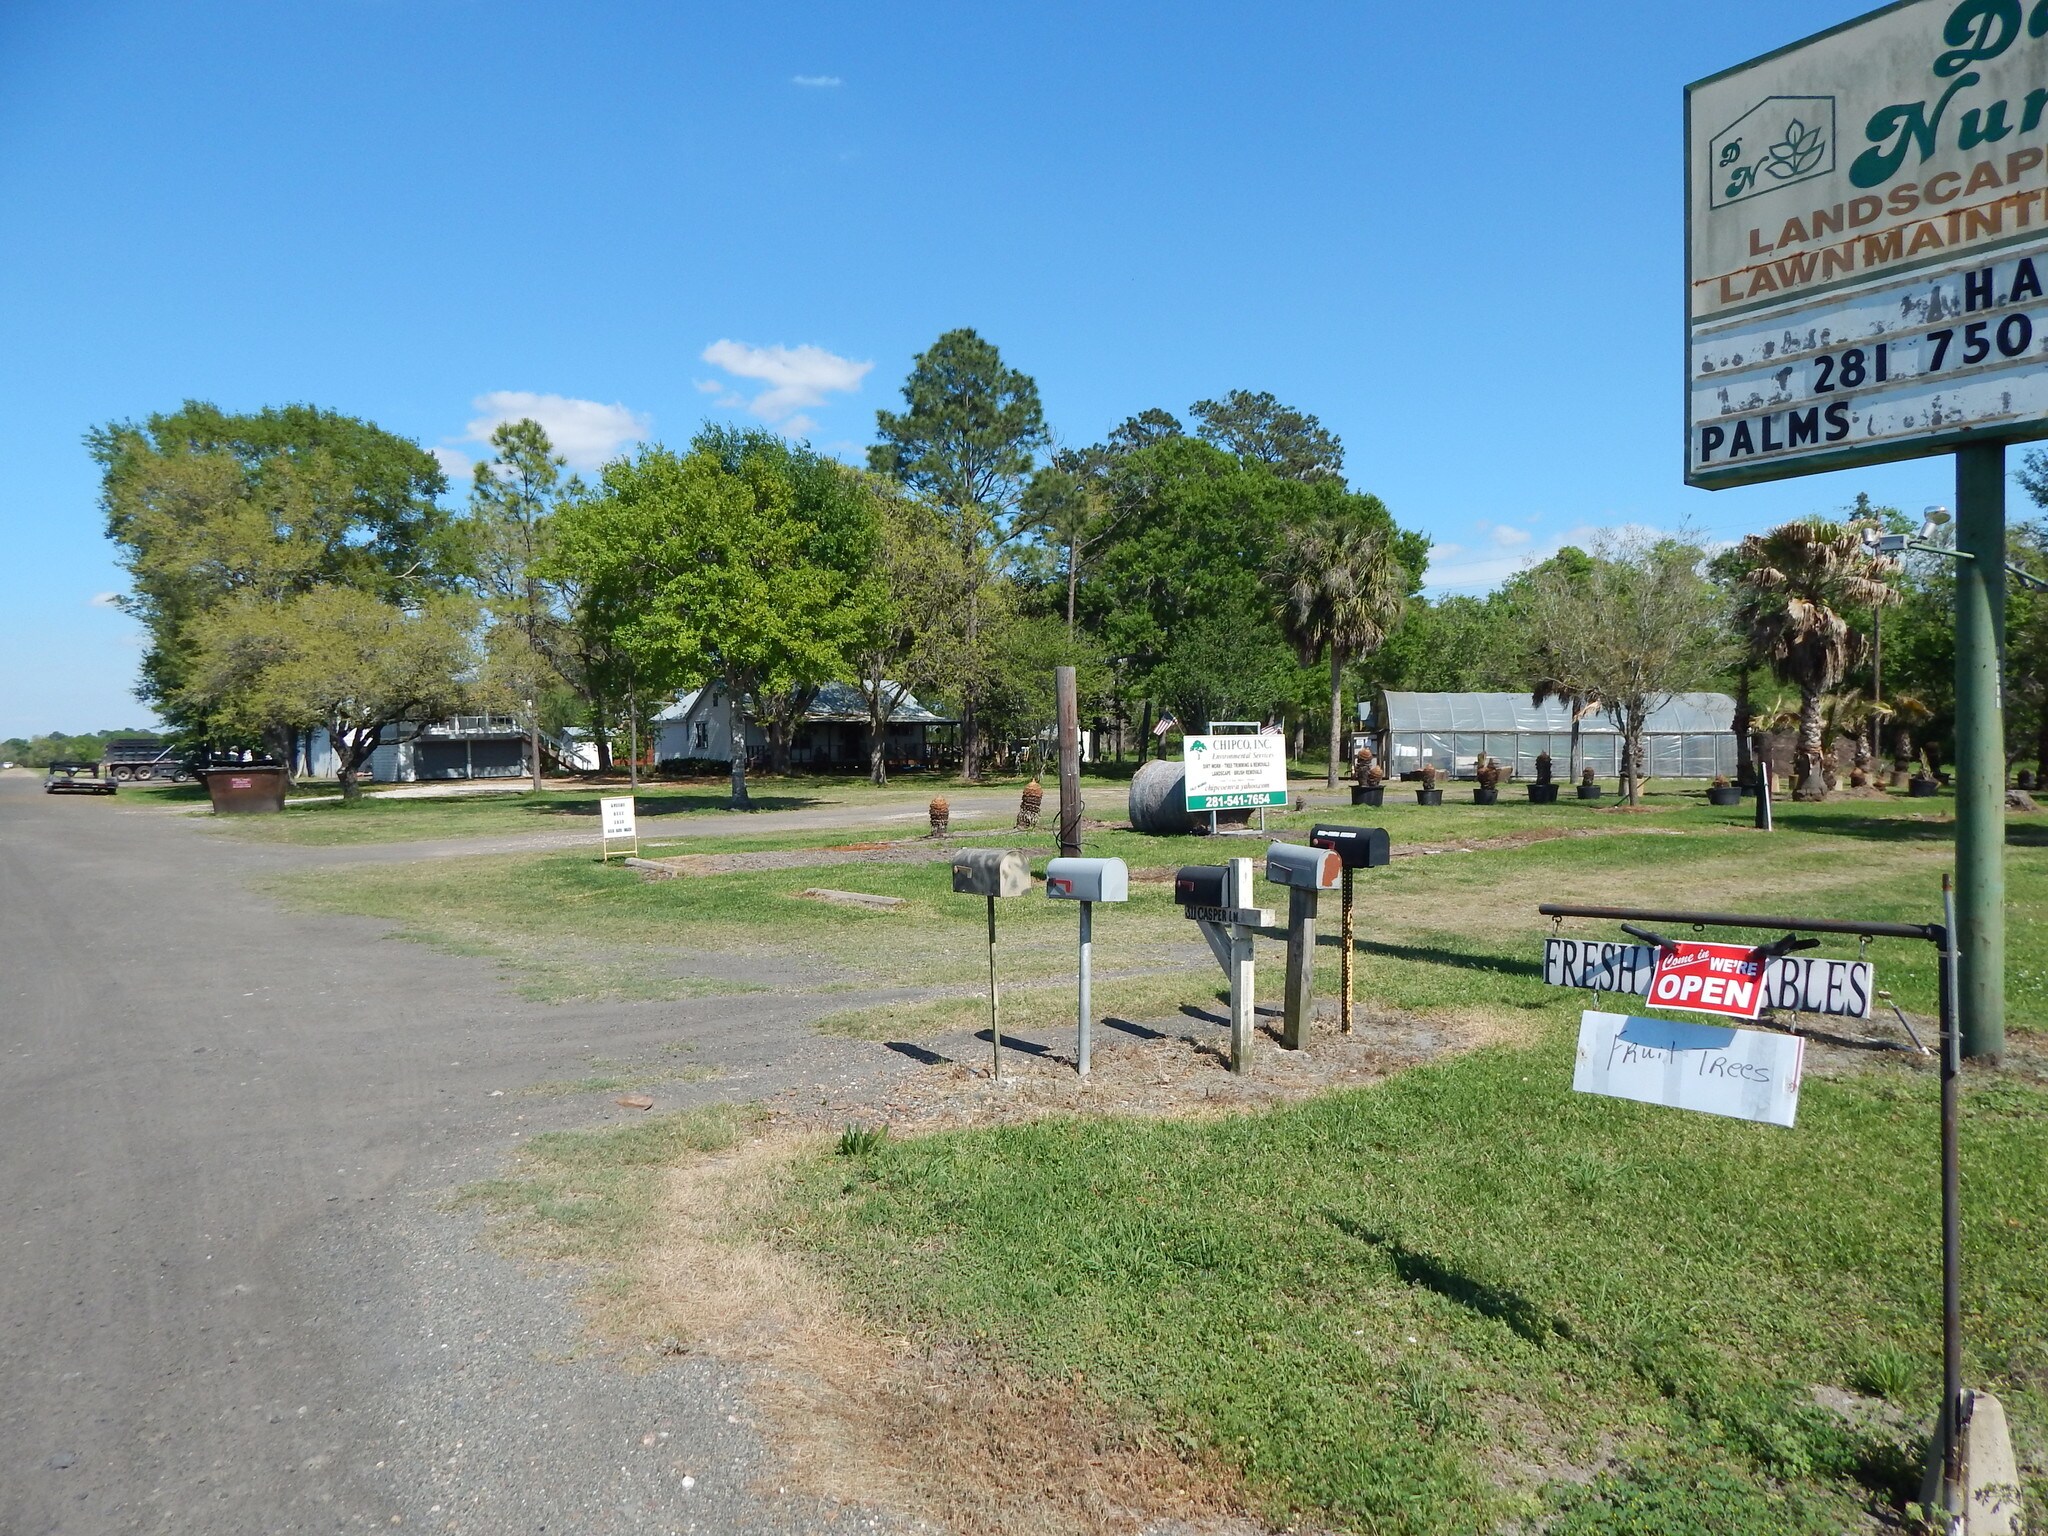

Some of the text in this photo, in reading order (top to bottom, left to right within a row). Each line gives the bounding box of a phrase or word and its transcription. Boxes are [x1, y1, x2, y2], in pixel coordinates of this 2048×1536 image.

[1719, 136, 1743, 168] D
[1725, 155, 1770, 198] N
[1749, 146, 2048, 257] LANDSCAP
[1813, 313, 2033, 394] 281 750
[1701, 401, 1850, 463] PALMS
[1212, 739, 1272, 750] CHIPCO, INC.
[1206, 794, 1270, 808] 281-541-7654
[1198, 906, 1227, 922] CASPER
[1543, 938, 1639, 995] FRESH
[1661, 953, 1695, 971] Come
[1709, 956, 1758, 976] WE'RE
[1657, 973, 1754, 1009] OPEN
